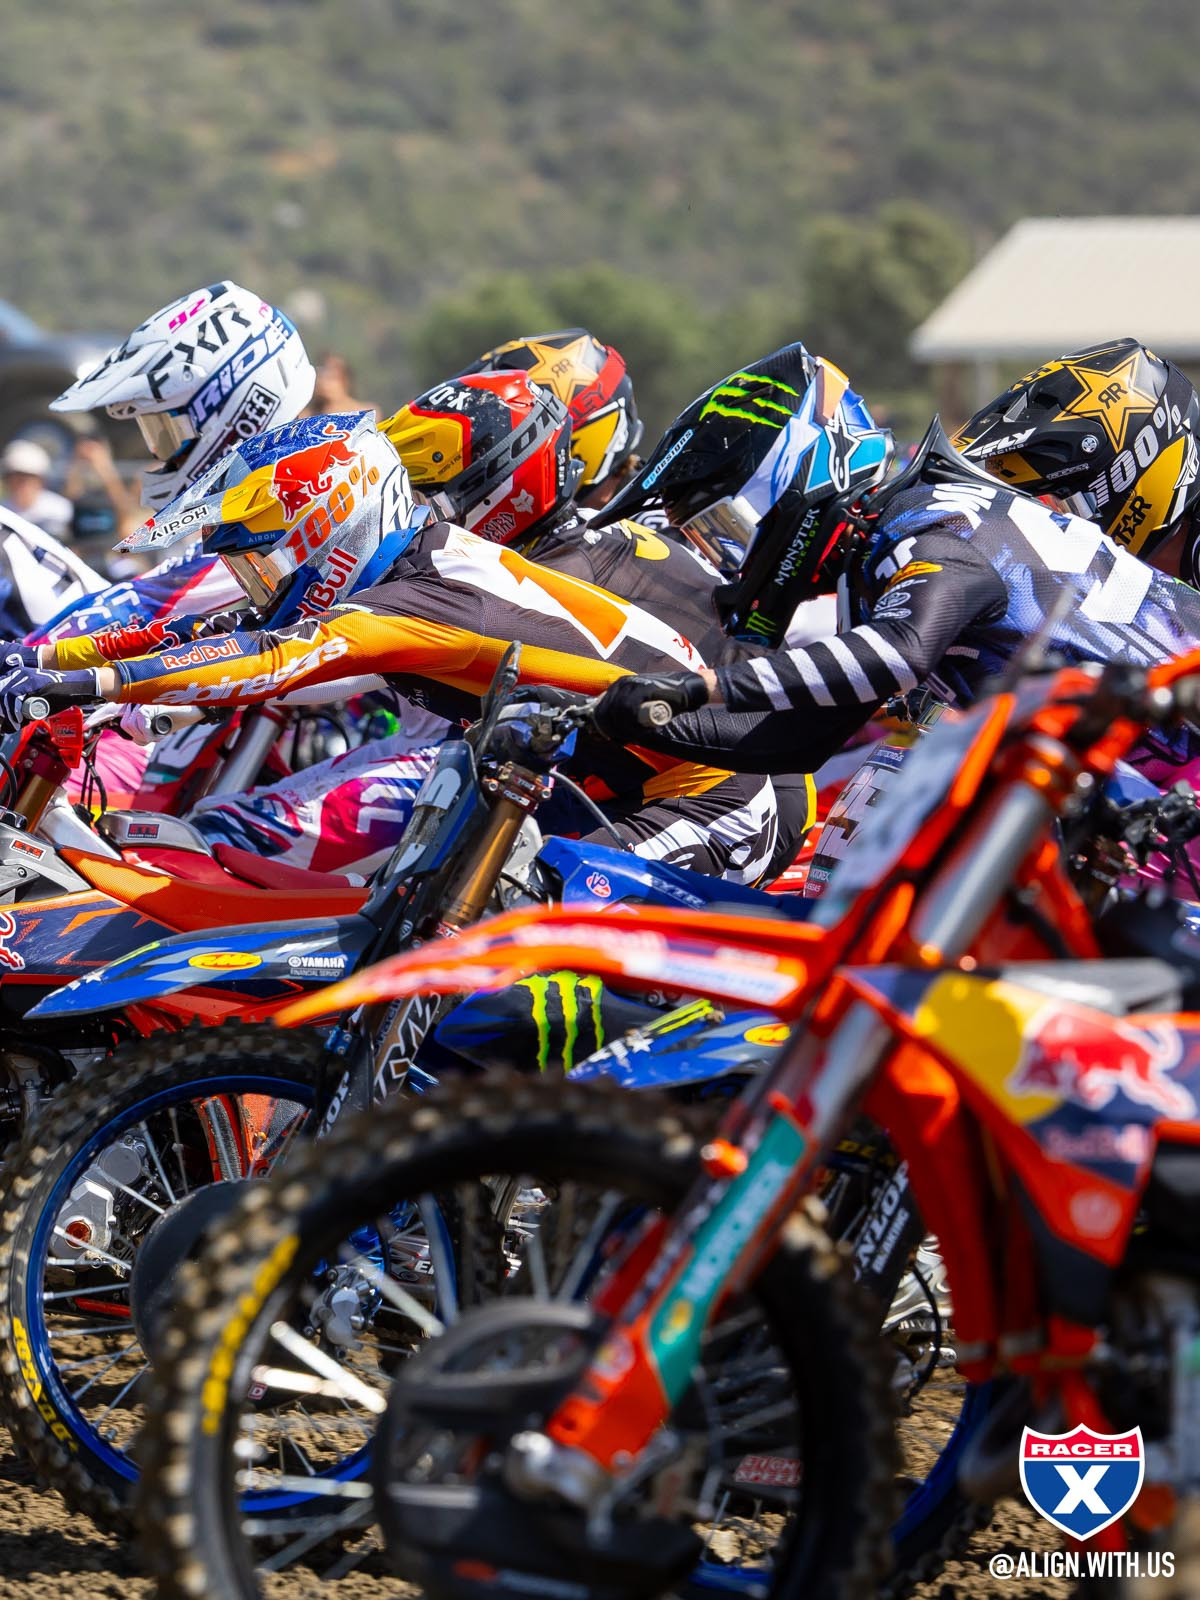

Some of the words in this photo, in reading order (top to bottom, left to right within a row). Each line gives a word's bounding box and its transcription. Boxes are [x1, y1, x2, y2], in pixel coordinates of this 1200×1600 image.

[1088, 394, 1181, 507] 100%
[150, 505, 209, 541] AIROH
[285, 455, 380, 565] 100%
[248, 532, 277, 543] AIROH
[313, 546, 359, 610] Bull
[162, 648, 203, 669] Red
[202, 638, 243, 662] Bull
[301, 956, 345, 968] YAMAHA
